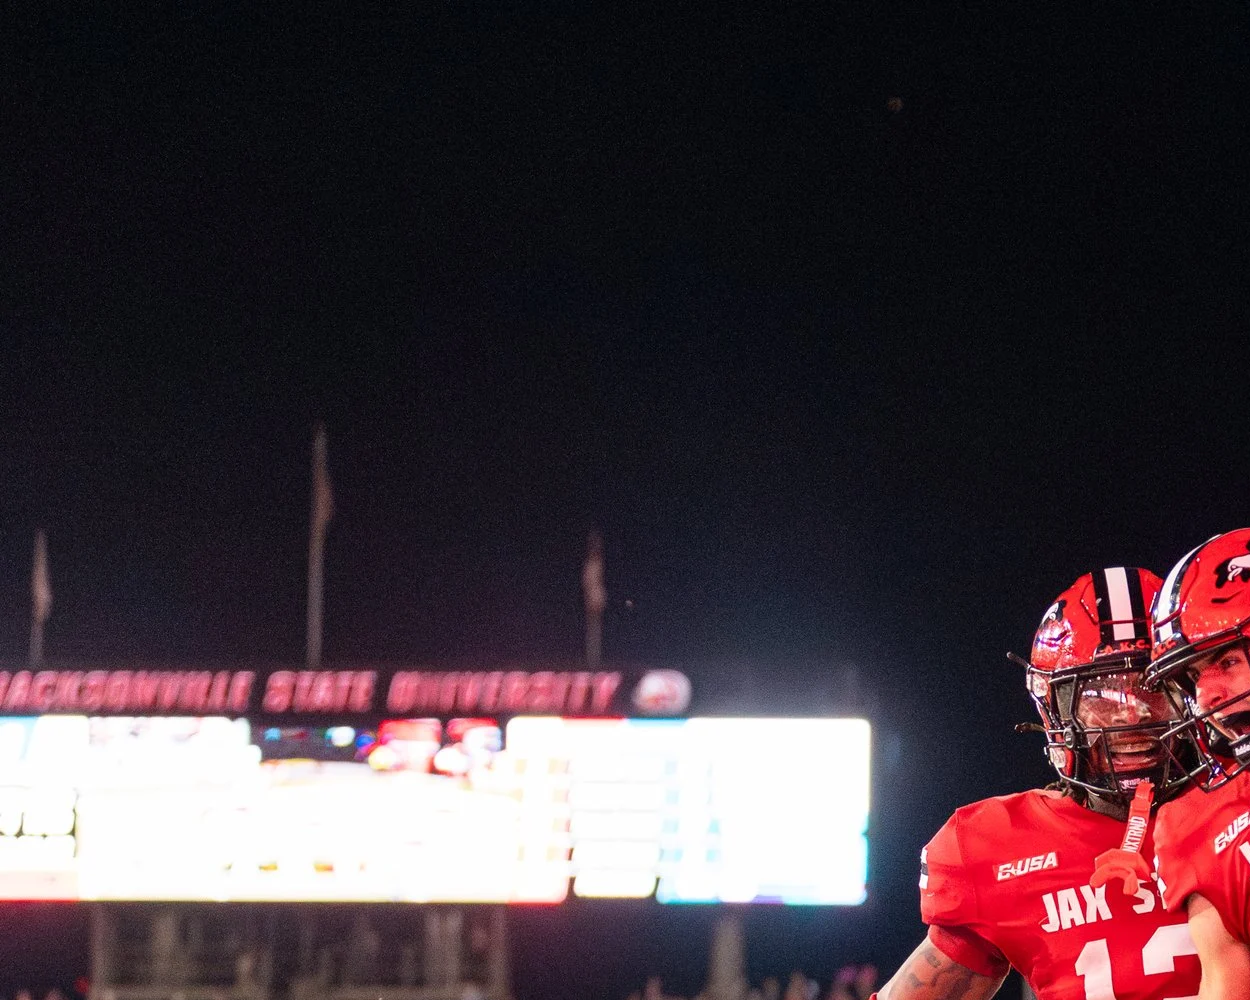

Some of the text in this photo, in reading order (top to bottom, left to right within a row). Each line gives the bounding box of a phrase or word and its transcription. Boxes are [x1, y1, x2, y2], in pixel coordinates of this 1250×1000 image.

[263, 670, 377, 713] STATE
[388, 670, 622, 713] UNIVERSITY
[1121, 816, 1147, 853] NXTRND
[1041, 883, 1113, 933] JAX
